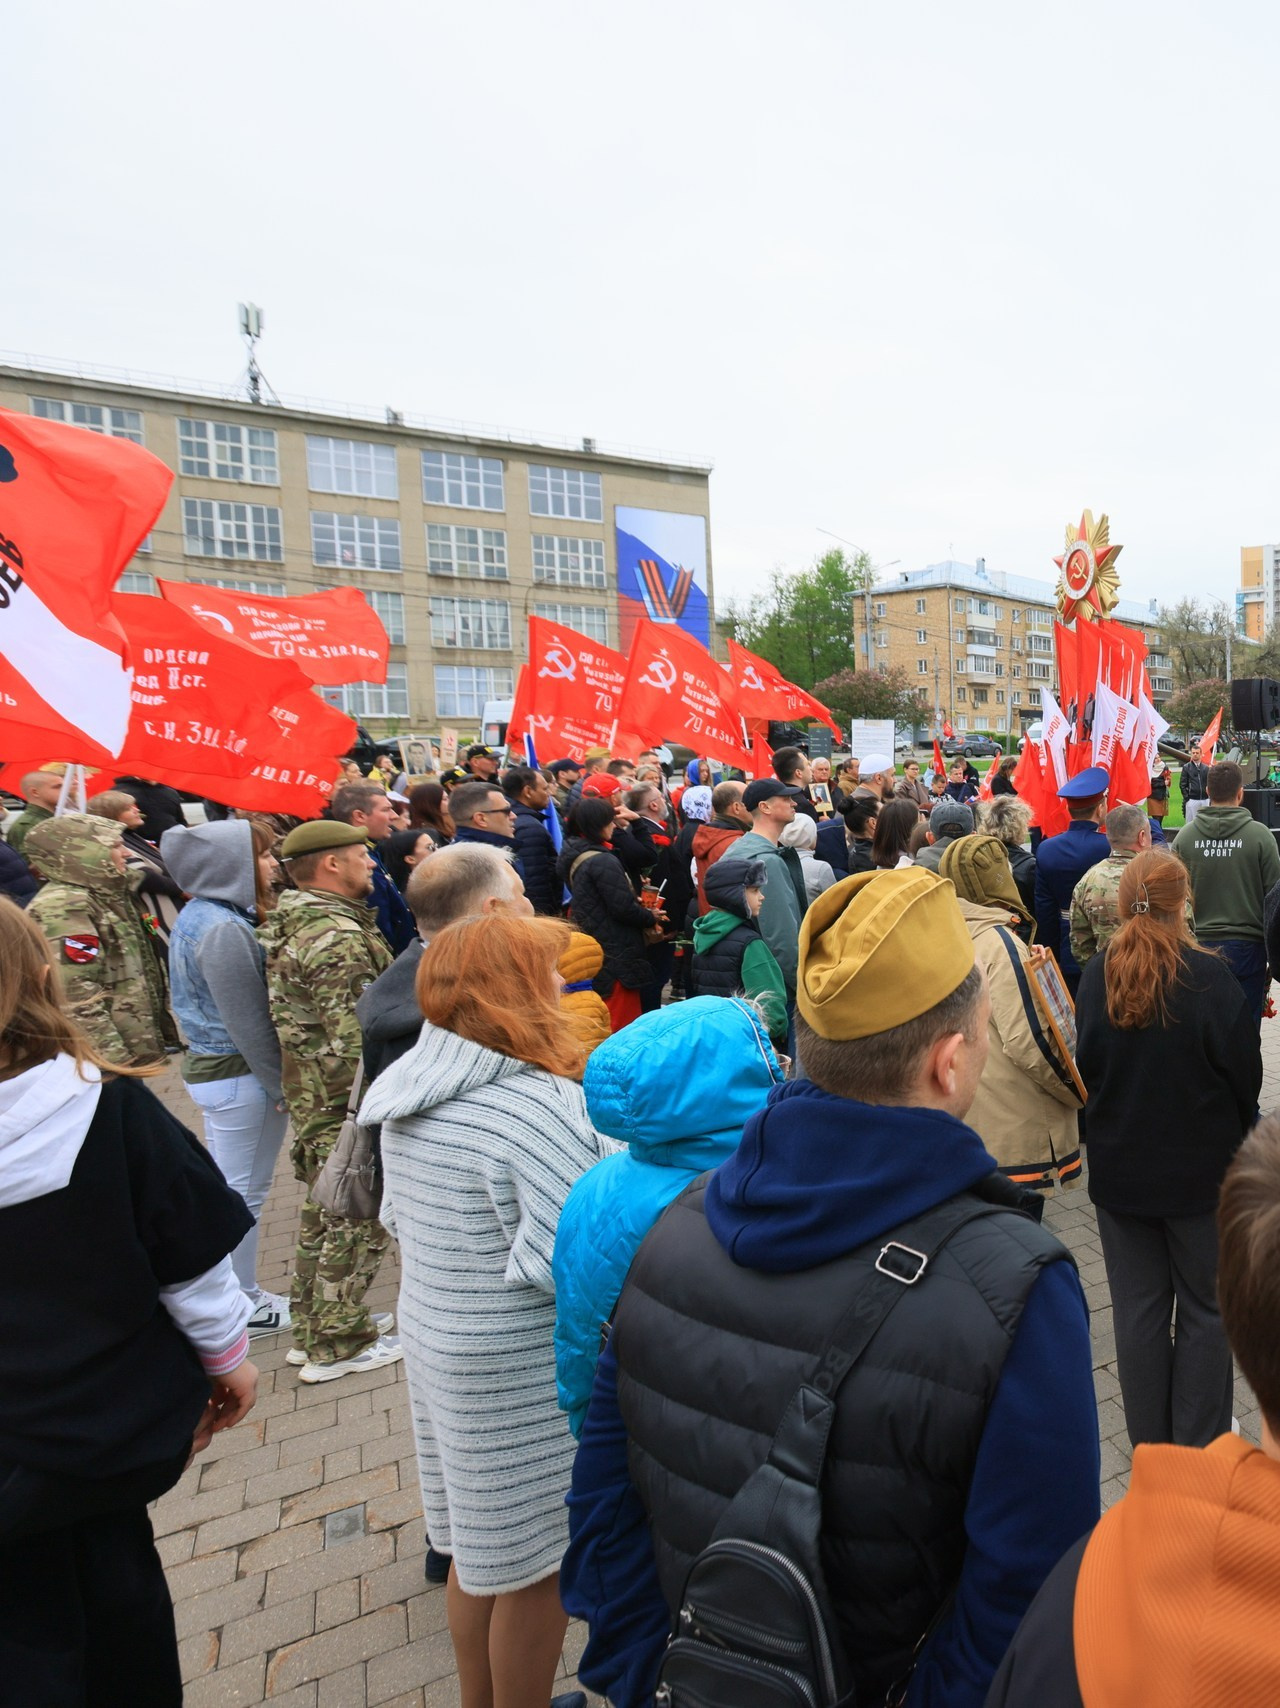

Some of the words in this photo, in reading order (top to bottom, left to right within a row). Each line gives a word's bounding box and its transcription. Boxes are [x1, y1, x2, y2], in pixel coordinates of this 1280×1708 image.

[269, 640, 295, 657] 79
[595, 691, 613, 712] 79
[785, 695, 797, 710] 79
[684, 711, 703, 734] 79
[567, 744, 584, 761] 79
[1098, 734, 1111, 757] ТУЛА
[1194, 838, 1243, 849] НАРОДНЫЙ
[1203, 848, 1233, 857] ФРОНТ
